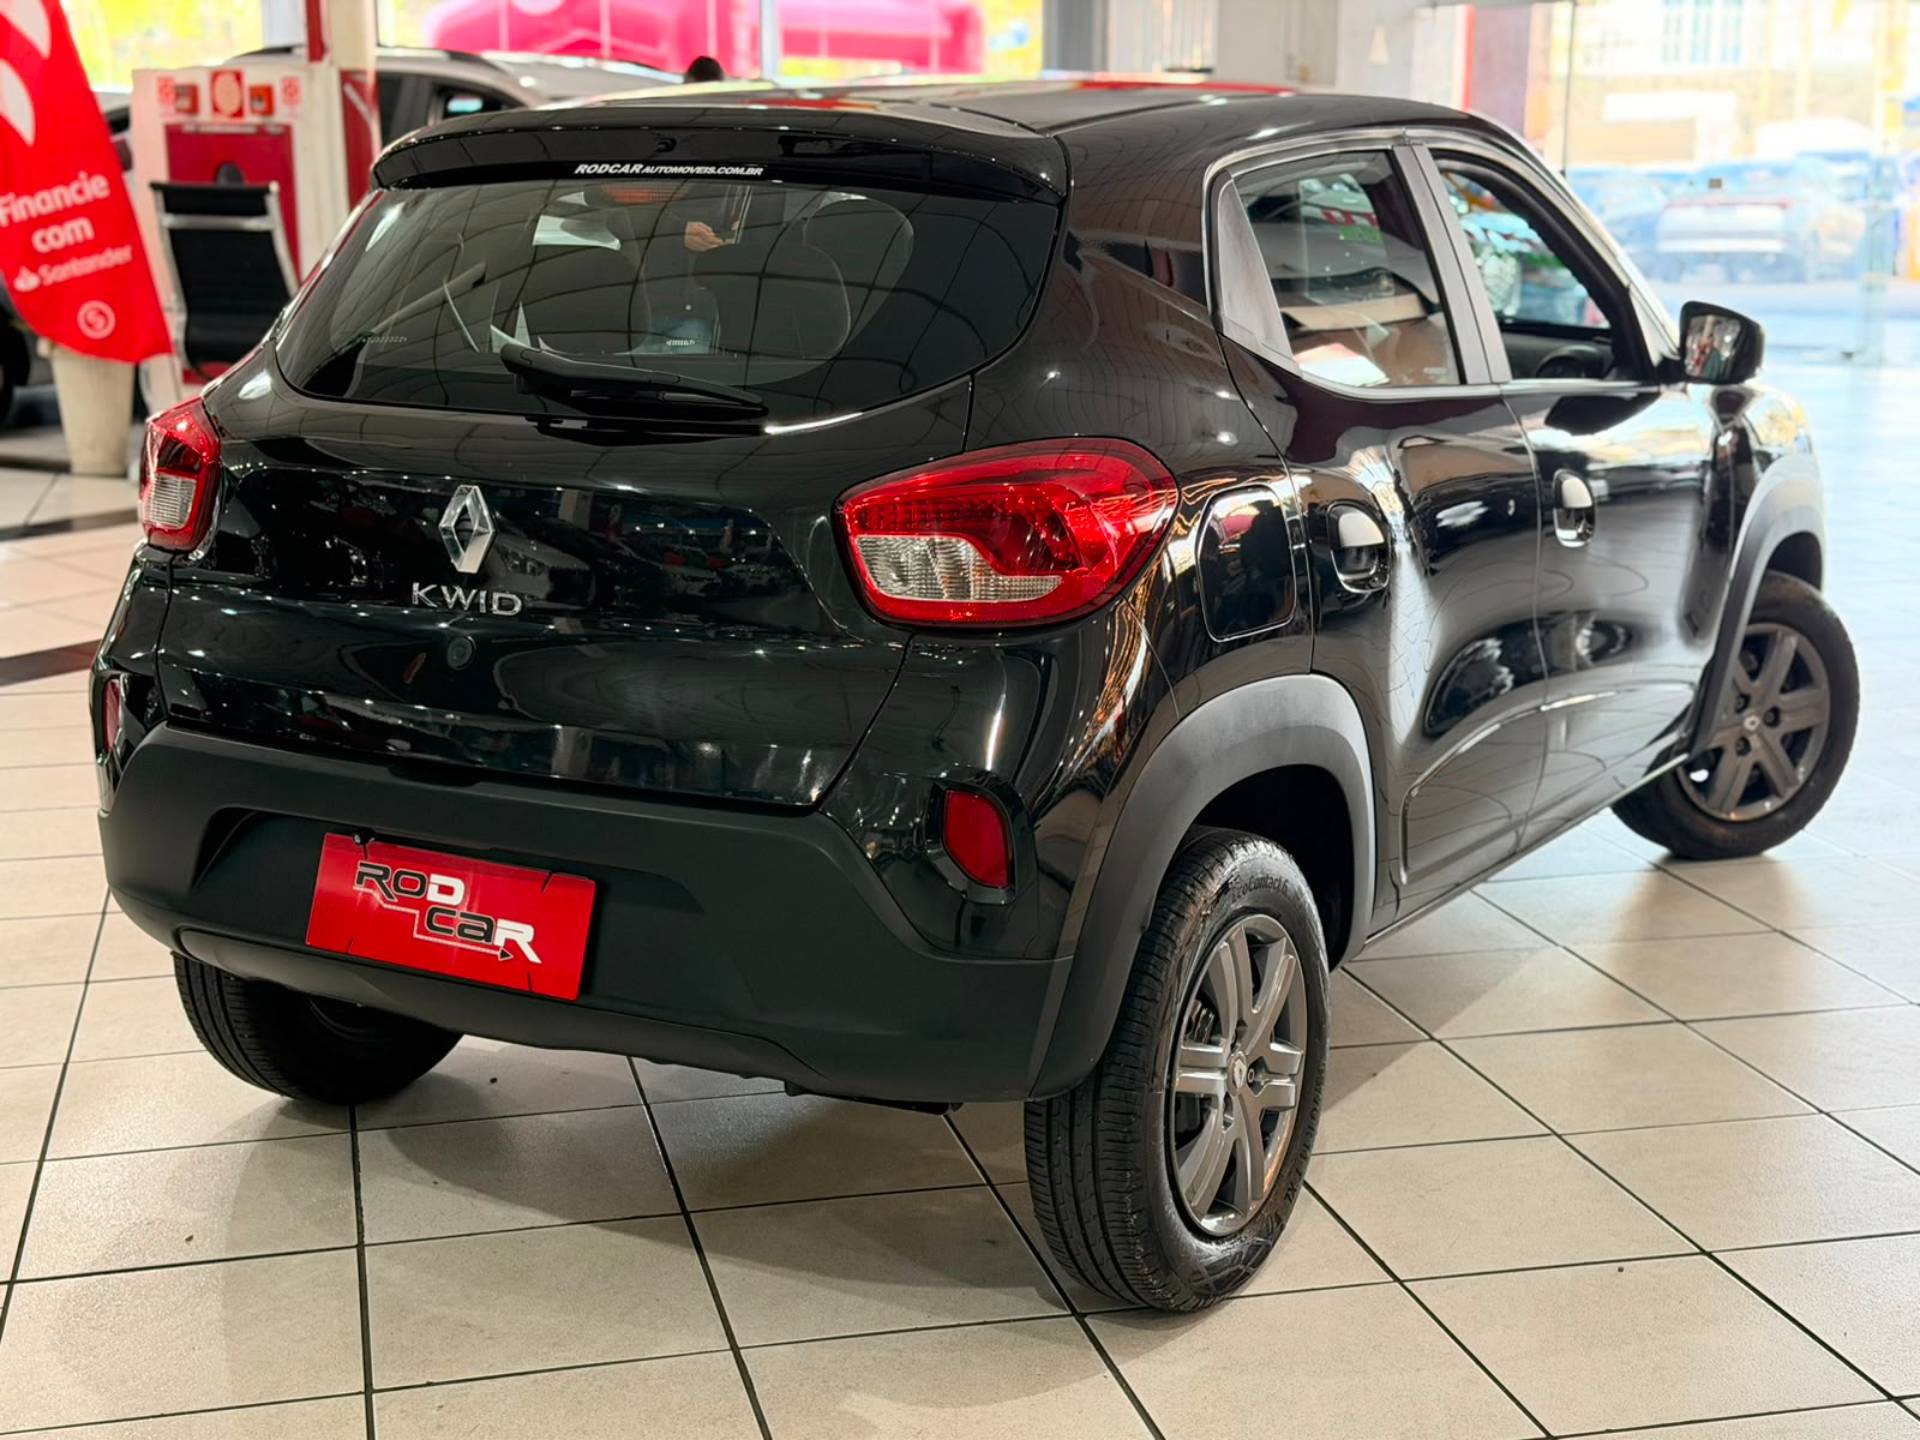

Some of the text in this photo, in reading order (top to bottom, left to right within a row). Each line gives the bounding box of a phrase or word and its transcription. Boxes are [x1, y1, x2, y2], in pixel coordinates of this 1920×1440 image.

[0, 170, 110, 228] Financie
[31, 217, 95, 254] com
[37, 244, 133, 286] Santander
[411, 582, 522, 616] KWID
